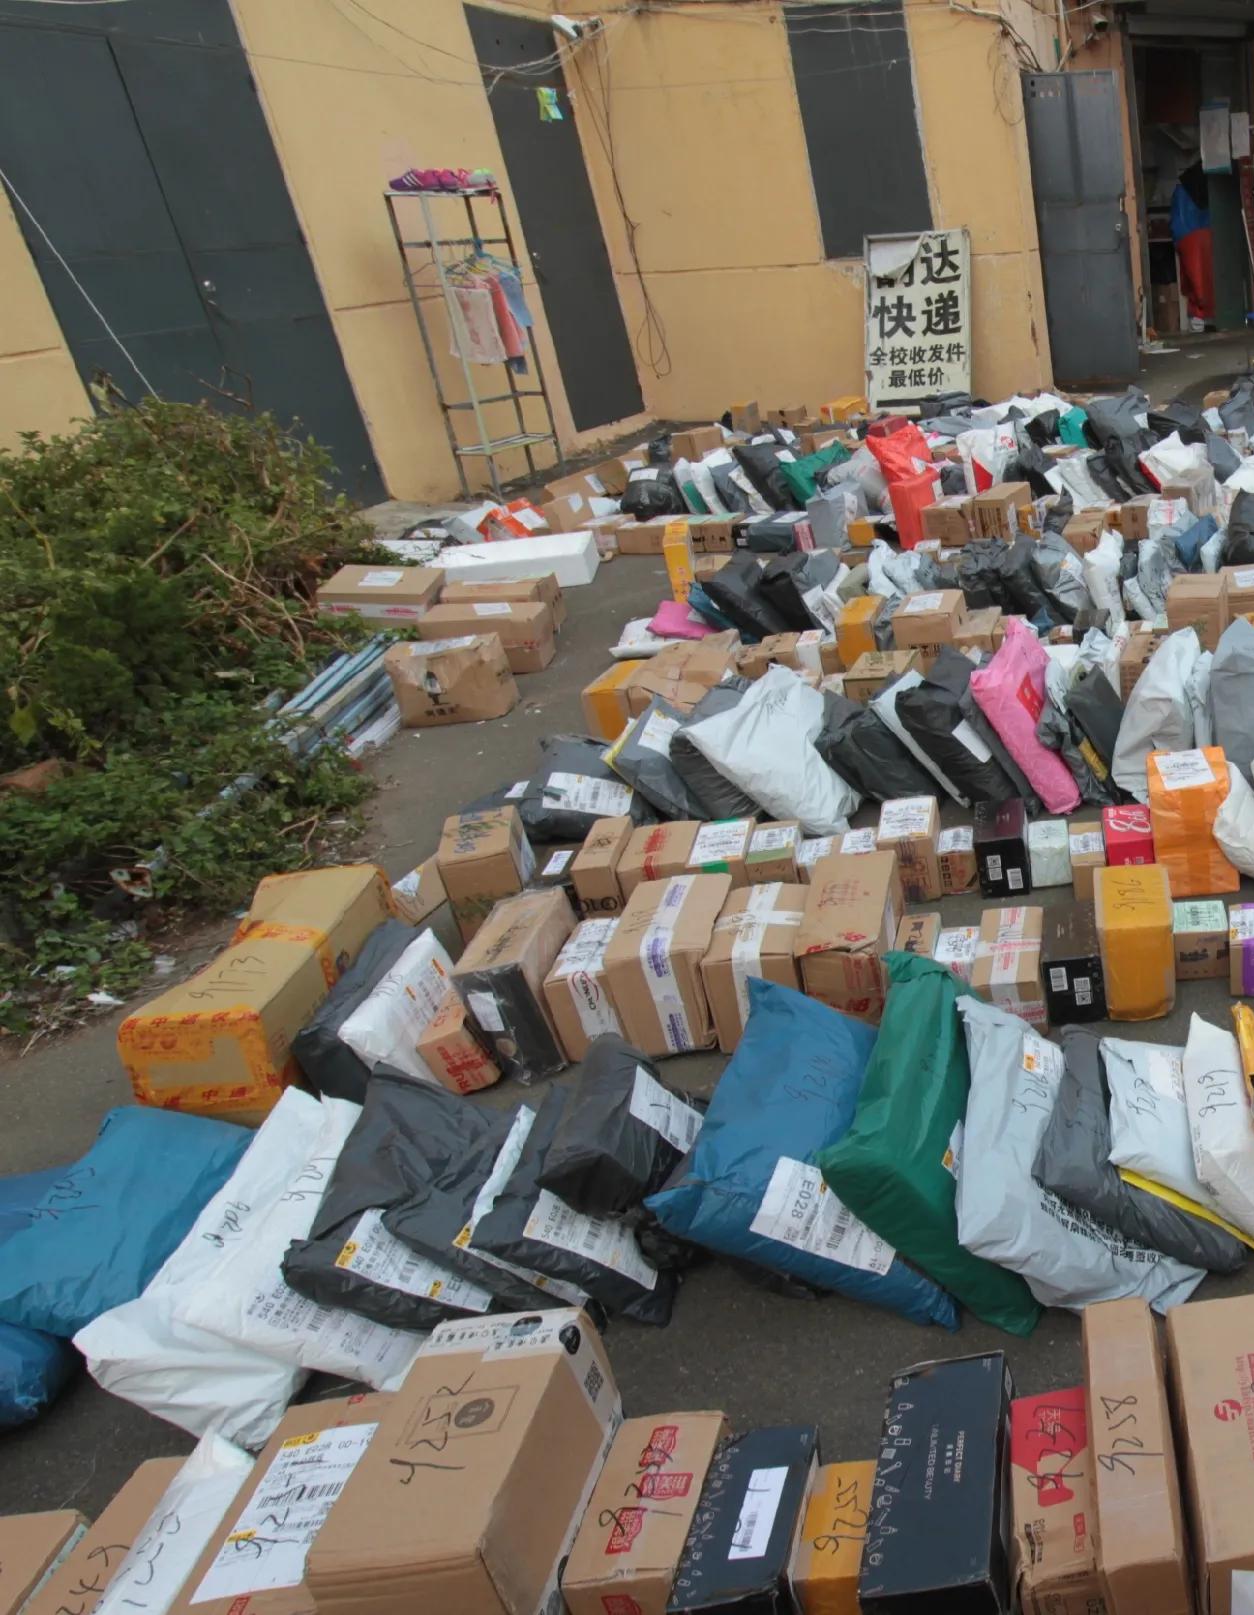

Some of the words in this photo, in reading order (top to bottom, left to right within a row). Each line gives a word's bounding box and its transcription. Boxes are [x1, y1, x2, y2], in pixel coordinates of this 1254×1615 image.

[872, 290, 962, 339] 快递
[870, 343, 966, 367] 全校收发件
[888, 367, 945, 389] 最低价
[1197, 1069, 1238, 1118] 9219
[1098, 1395, 1164, 1475] 9258
[813, 1477, 871, 1555] 9255
